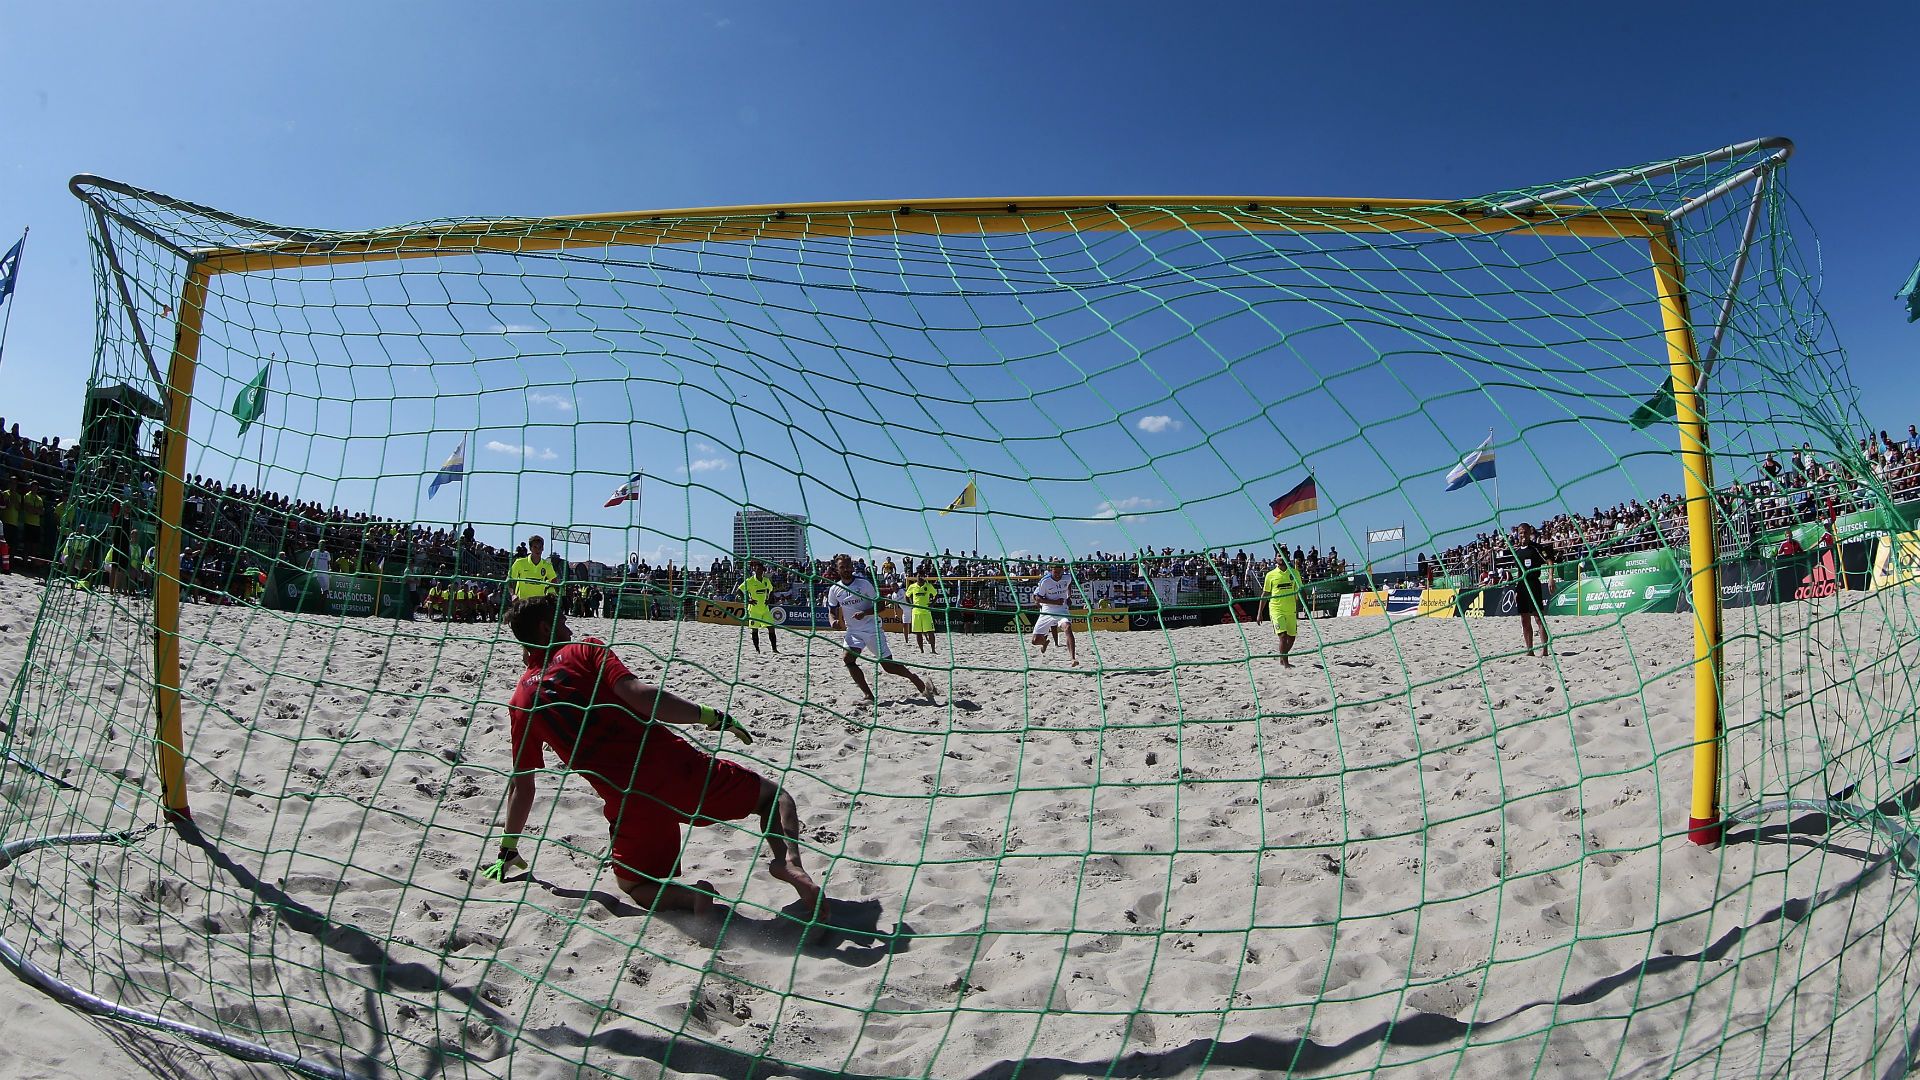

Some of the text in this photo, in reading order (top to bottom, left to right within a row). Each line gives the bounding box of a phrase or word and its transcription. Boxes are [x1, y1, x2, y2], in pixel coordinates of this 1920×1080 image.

[335, 581, 361, 590] DEUTSHE
[1153, 614, 1198, 622] Mrcedes-Benz
[1221, 615, 1252, 624] addas
[1003, 623, 1035, 632] addas
